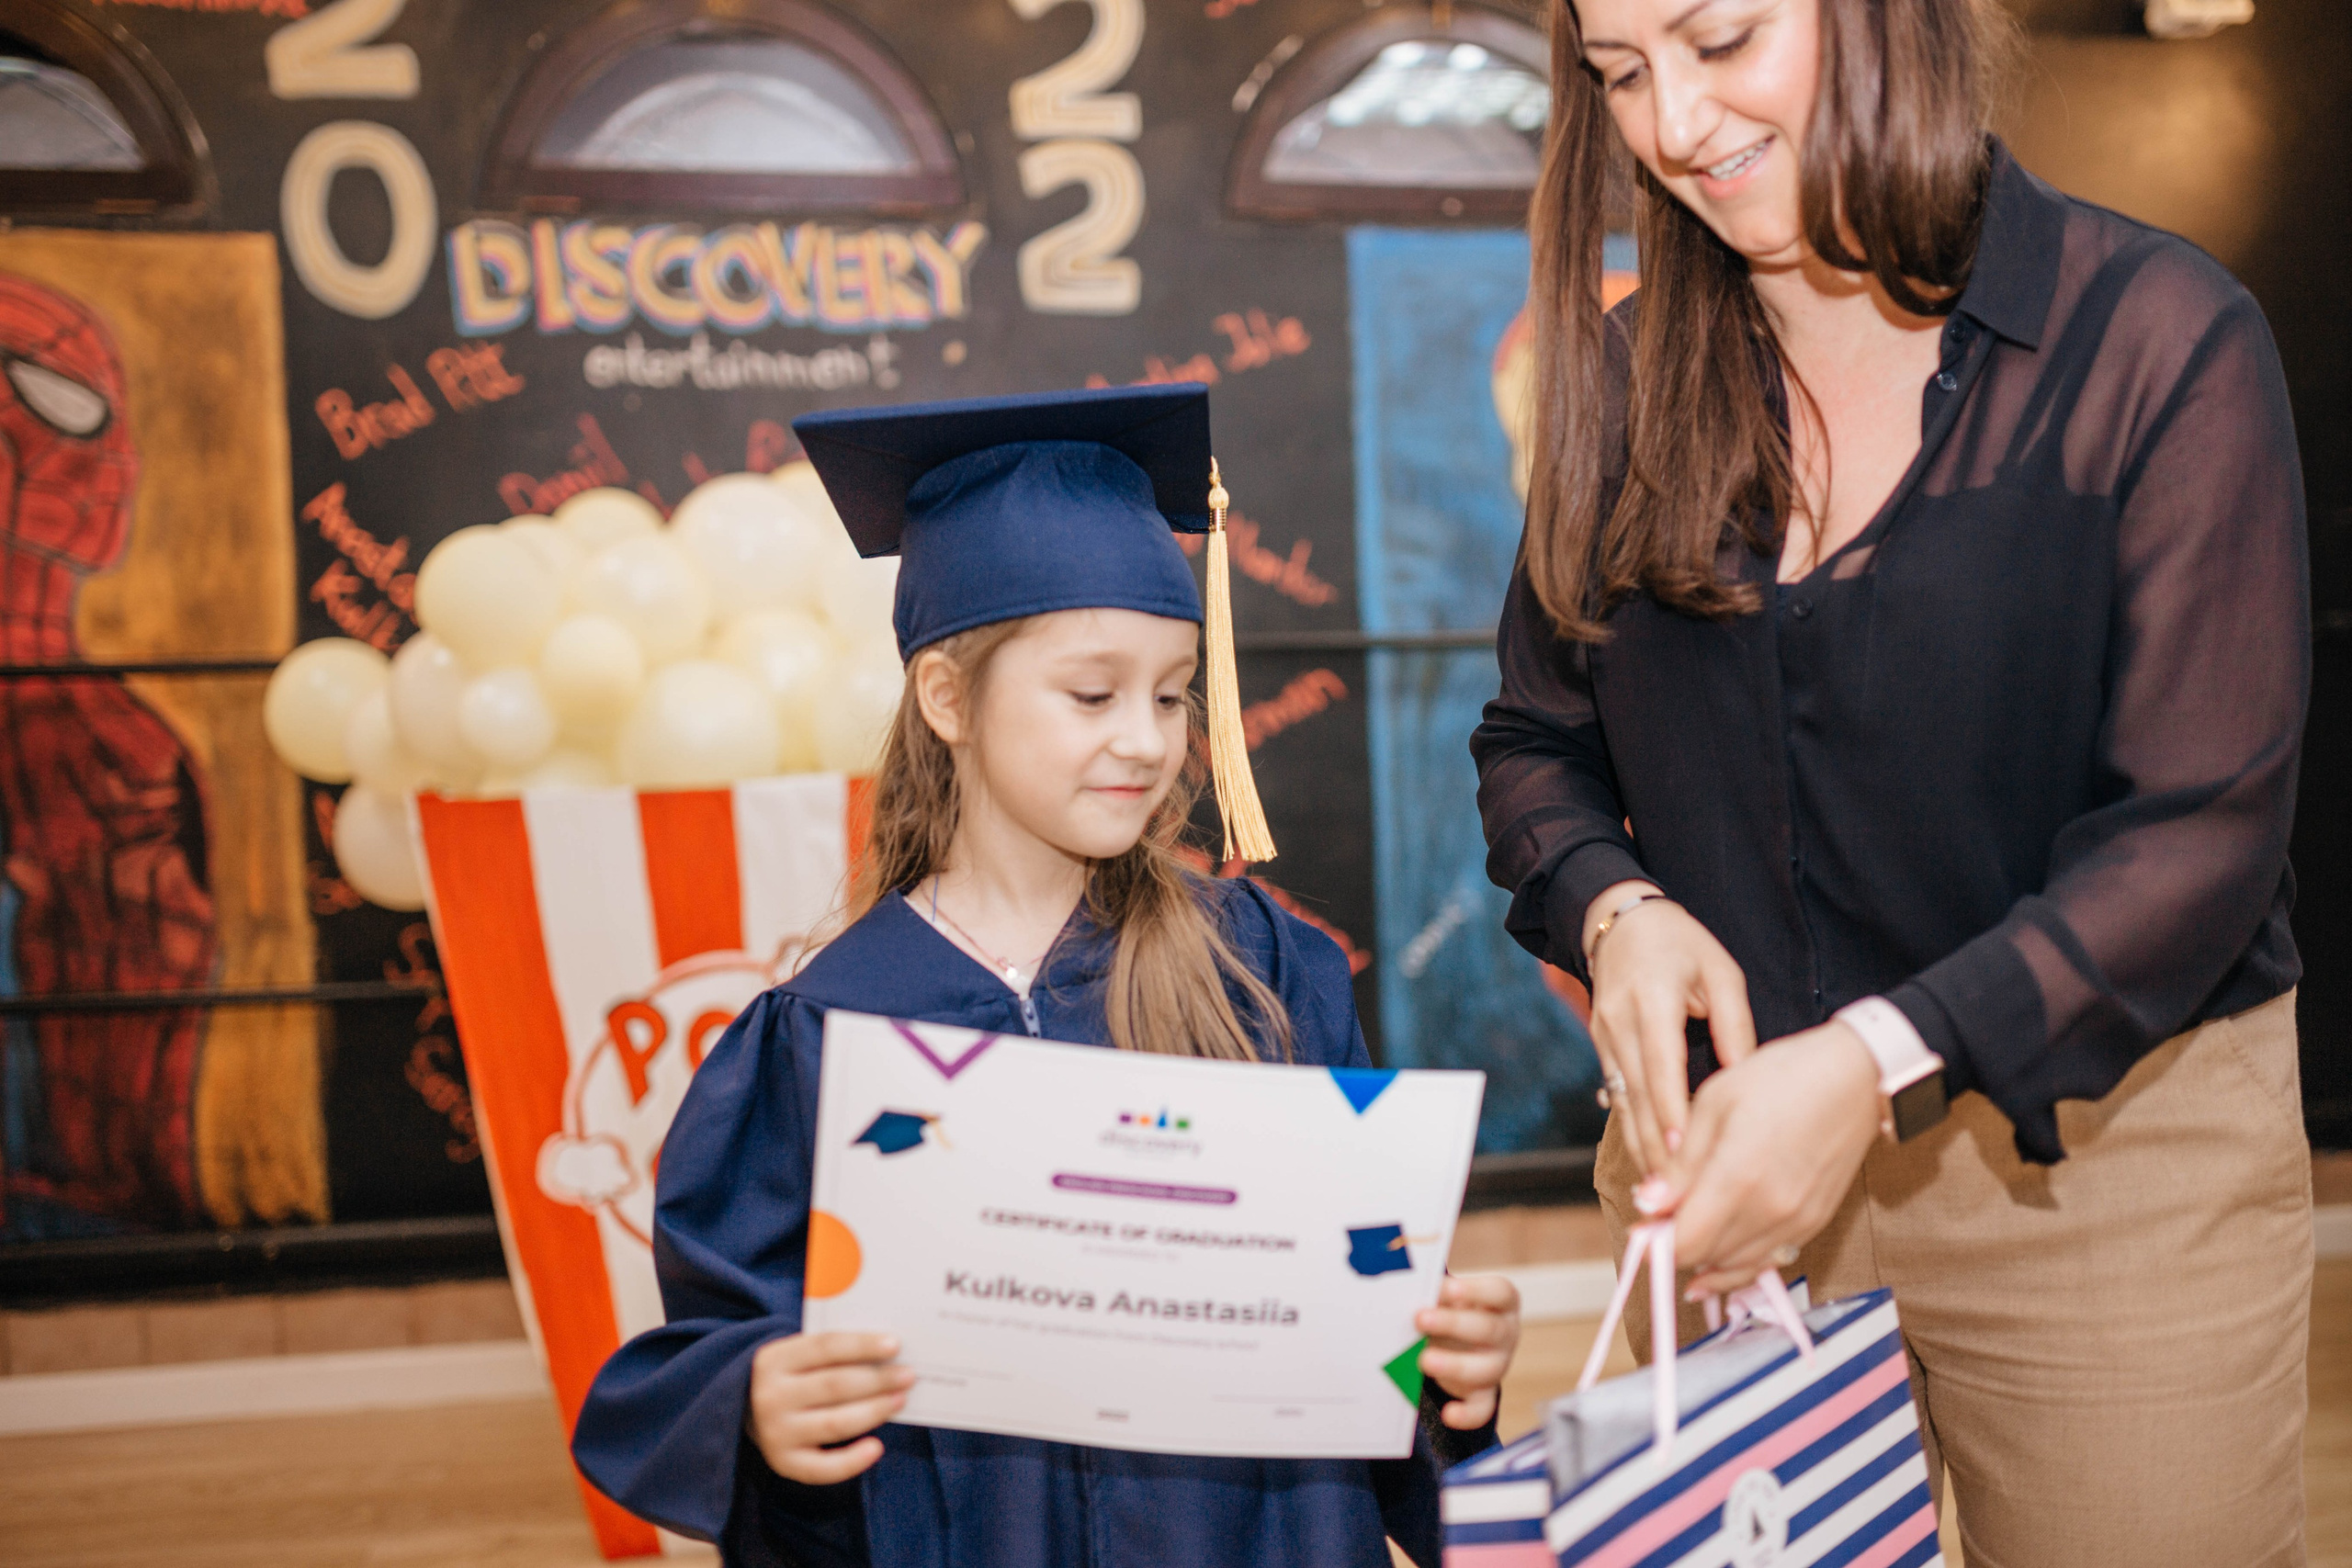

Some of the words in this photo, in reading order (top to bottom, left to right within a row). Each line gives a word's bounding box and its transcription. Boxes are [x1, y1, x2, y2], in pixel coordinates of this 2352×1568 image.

[447, 217, 986, 336] DISCOVERY
[313, 364, 436, 461] Brad
[979, 1207, 1113, 1239] CERTIFICATE
[1118, 1222, 1148, 1242] OF
[1152, 1229, 1297, 1255] GRADUATION
[944, 1269, 1096, 1311] Kulkova
[1105, 1290, 1300, 1328] Anastasiia
